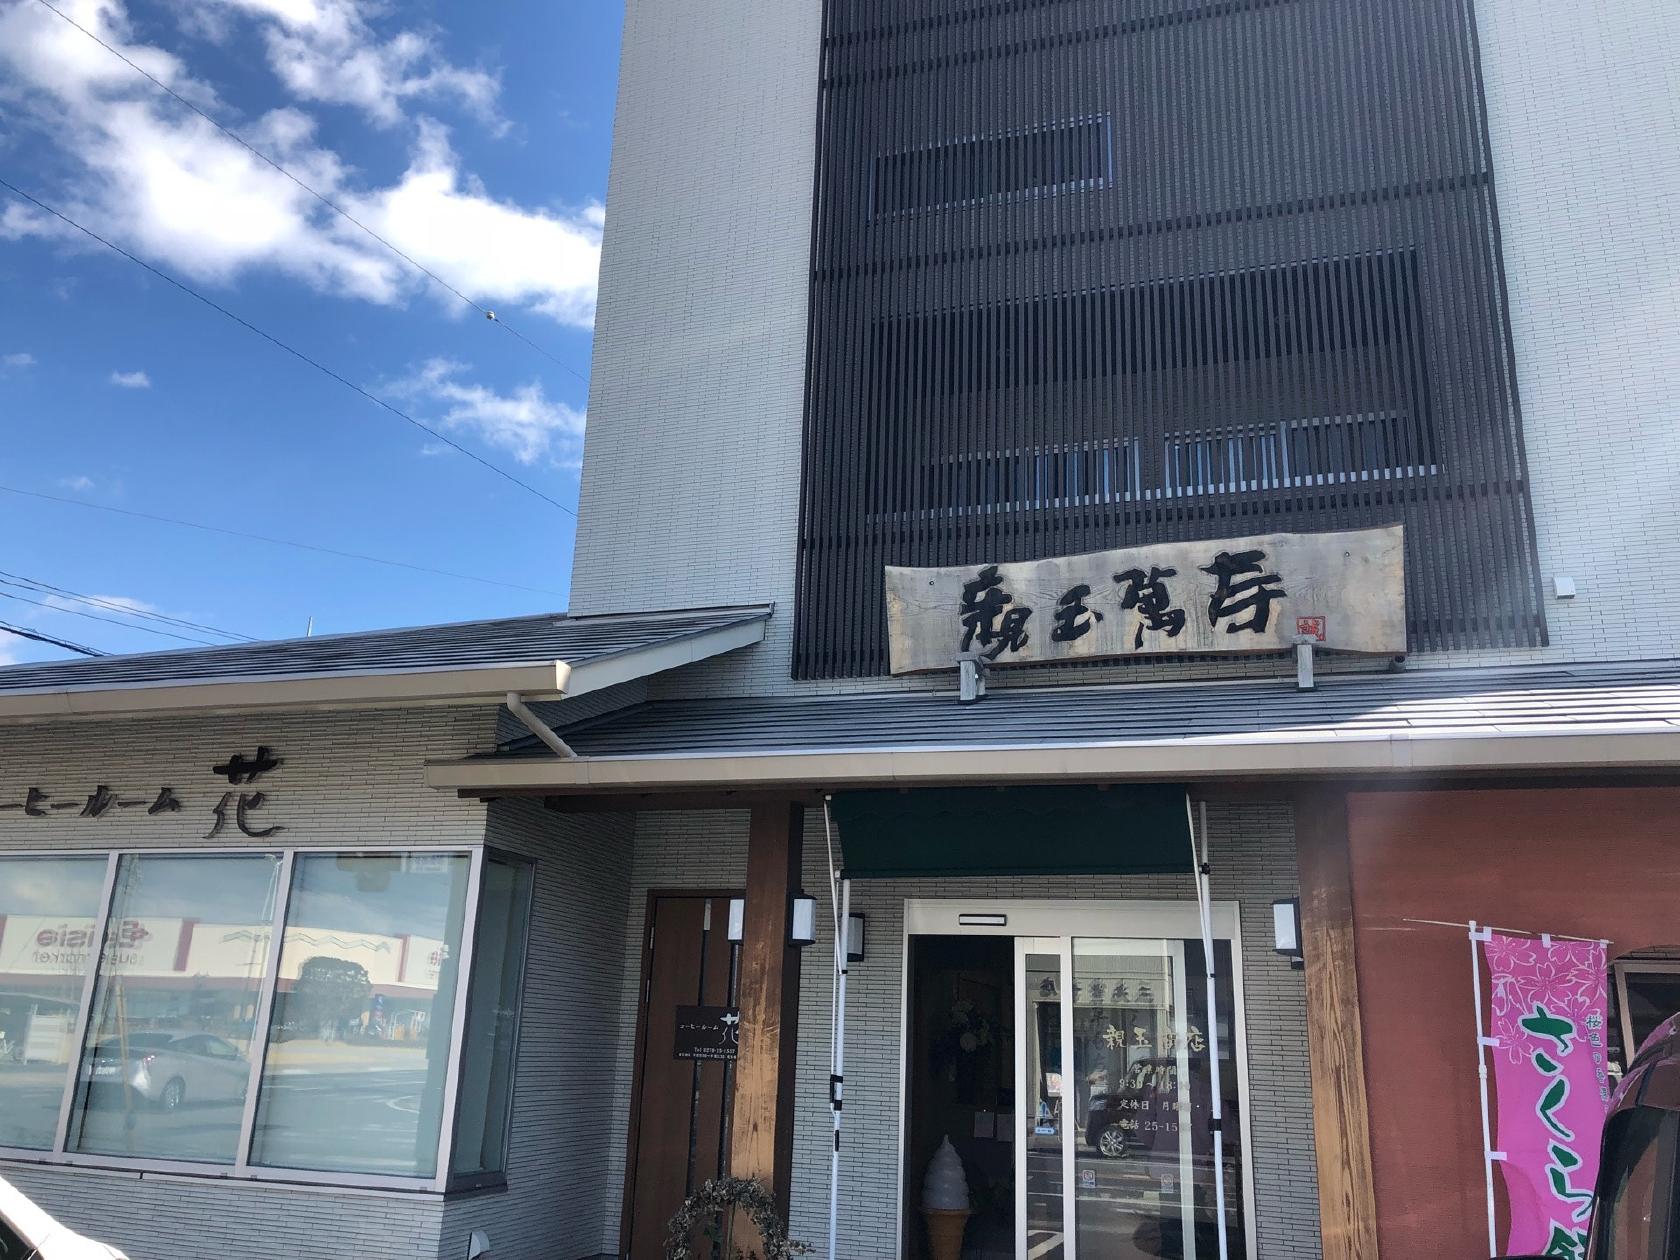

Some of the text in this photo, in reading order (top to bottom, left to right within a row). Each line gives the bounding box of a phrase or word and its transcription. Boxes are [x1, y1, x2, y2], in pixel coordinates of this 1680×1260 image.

[203, 745, 286, 839] 花
[679, 1023, 719, 1031] コーヒールーム
[1120, 1099, 1150, 1110] 定休日
